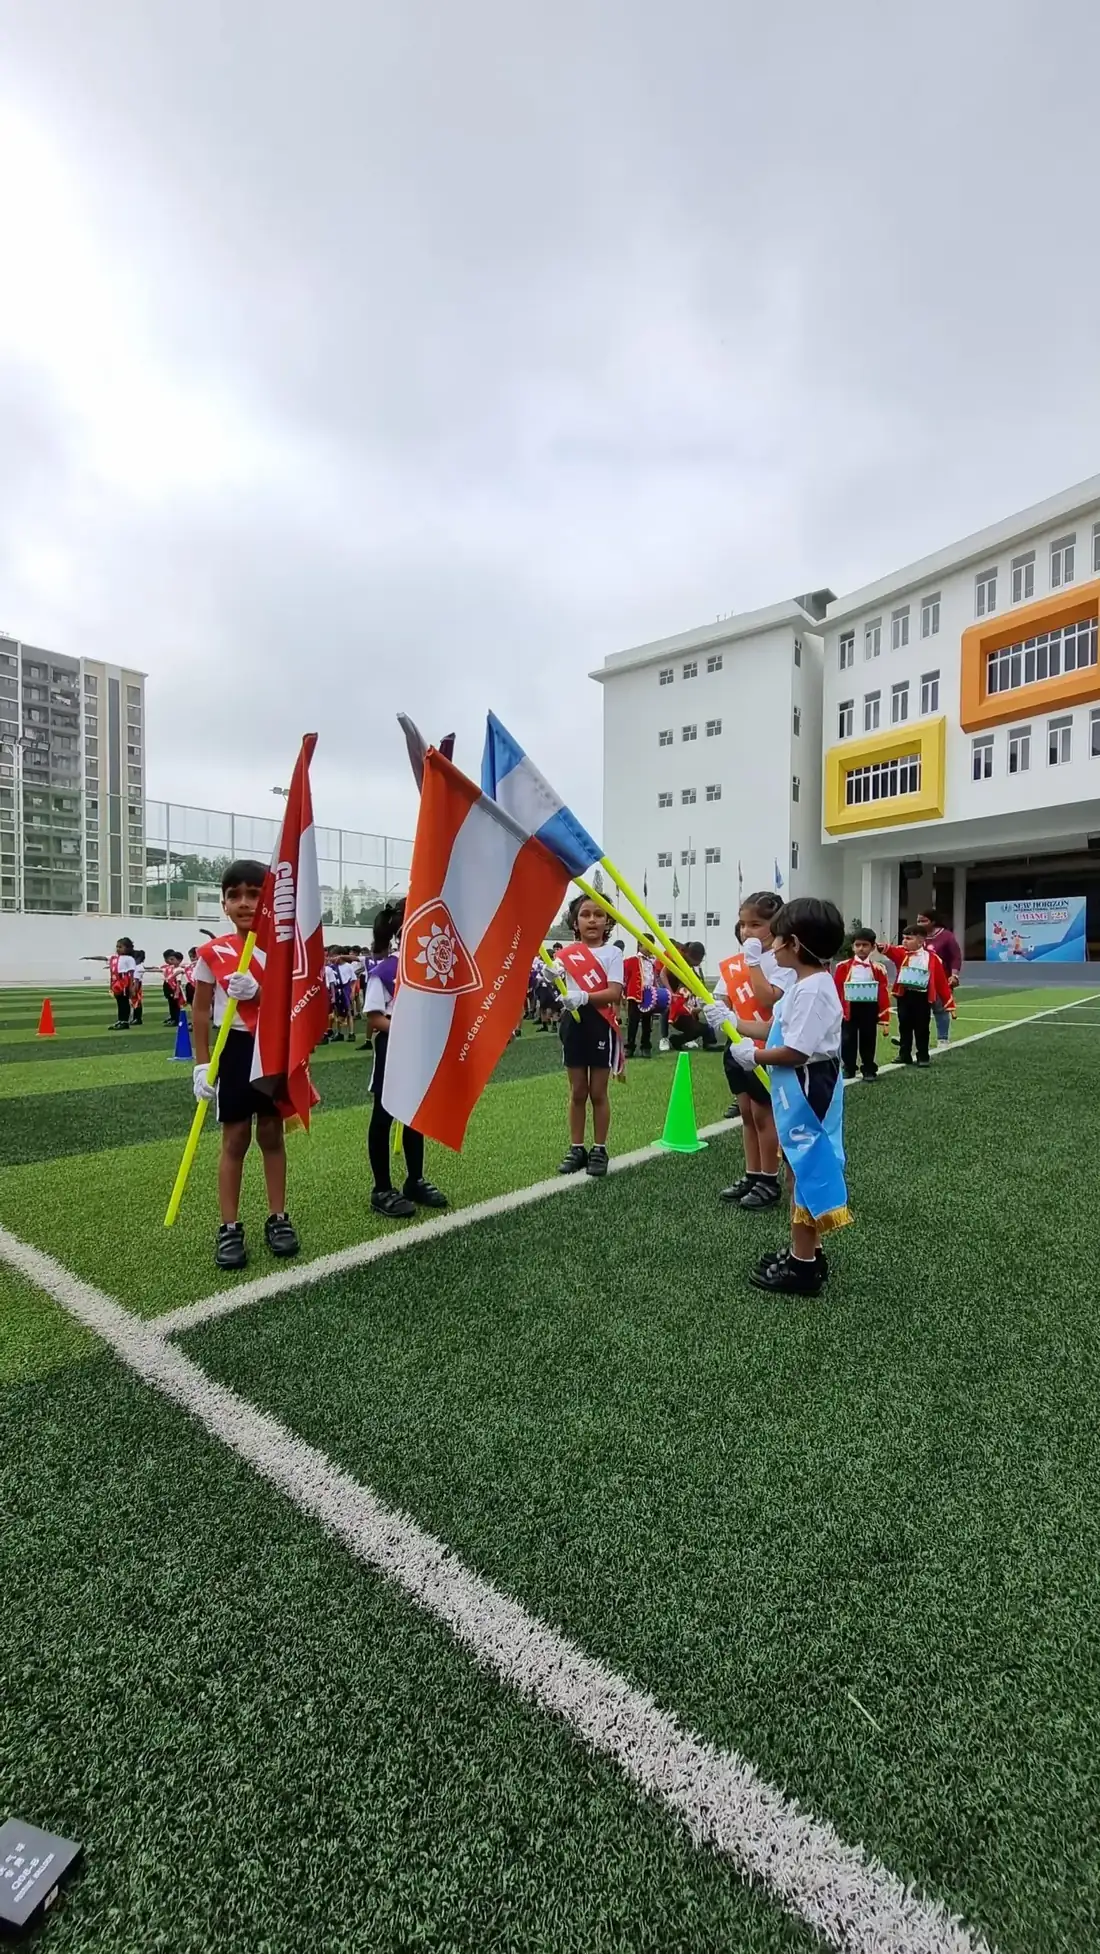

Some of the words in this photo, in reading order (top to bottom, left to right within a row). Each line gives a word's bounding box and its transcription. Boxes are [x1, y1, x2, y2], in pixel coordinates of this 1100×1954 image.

[273, 861, 296, 943] CHOLA
[1033, 900, 1069, 908] HORIZON
[467, 1011, 487, 1042] dare,
[481, 991, 497, 1012] We
[493, 973, 508, 991] do,
[501, 952, 516, 972] We
